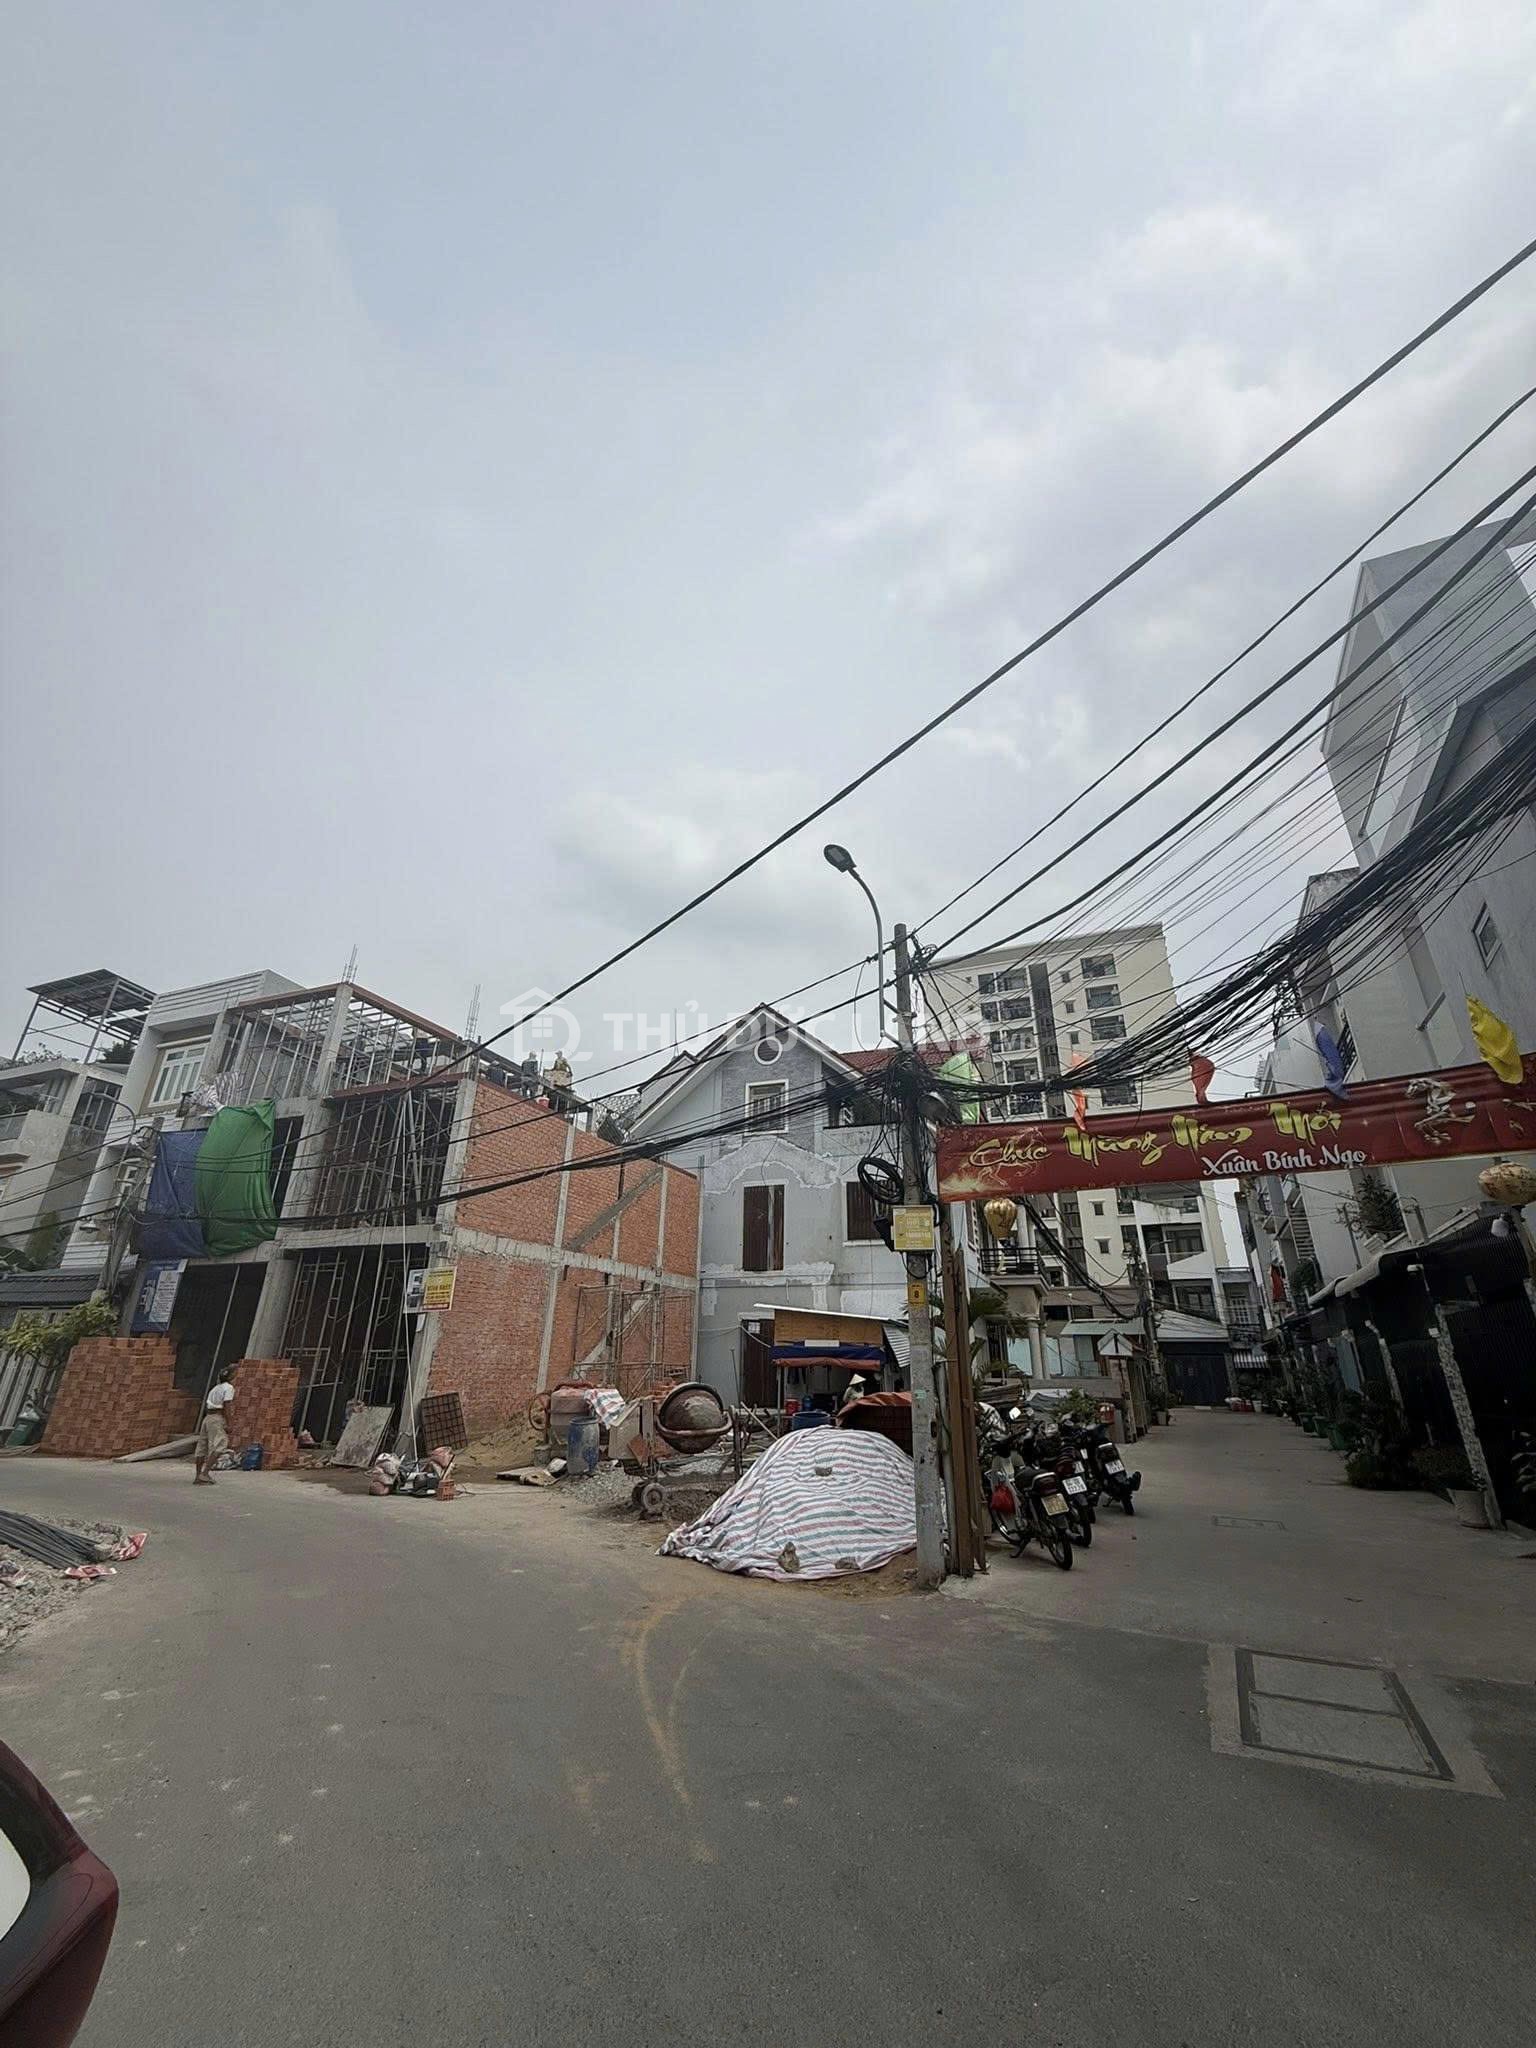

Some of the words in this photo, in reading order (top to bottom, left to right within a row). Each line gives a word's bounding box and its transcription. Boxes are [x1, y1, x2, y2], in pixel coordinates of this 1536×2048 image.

[969, 1139, 1053, 1168] Chúc
[1201, 1148, 1261, 1176] Xuân
[1263, 1147, 1316, 1171] Bính
